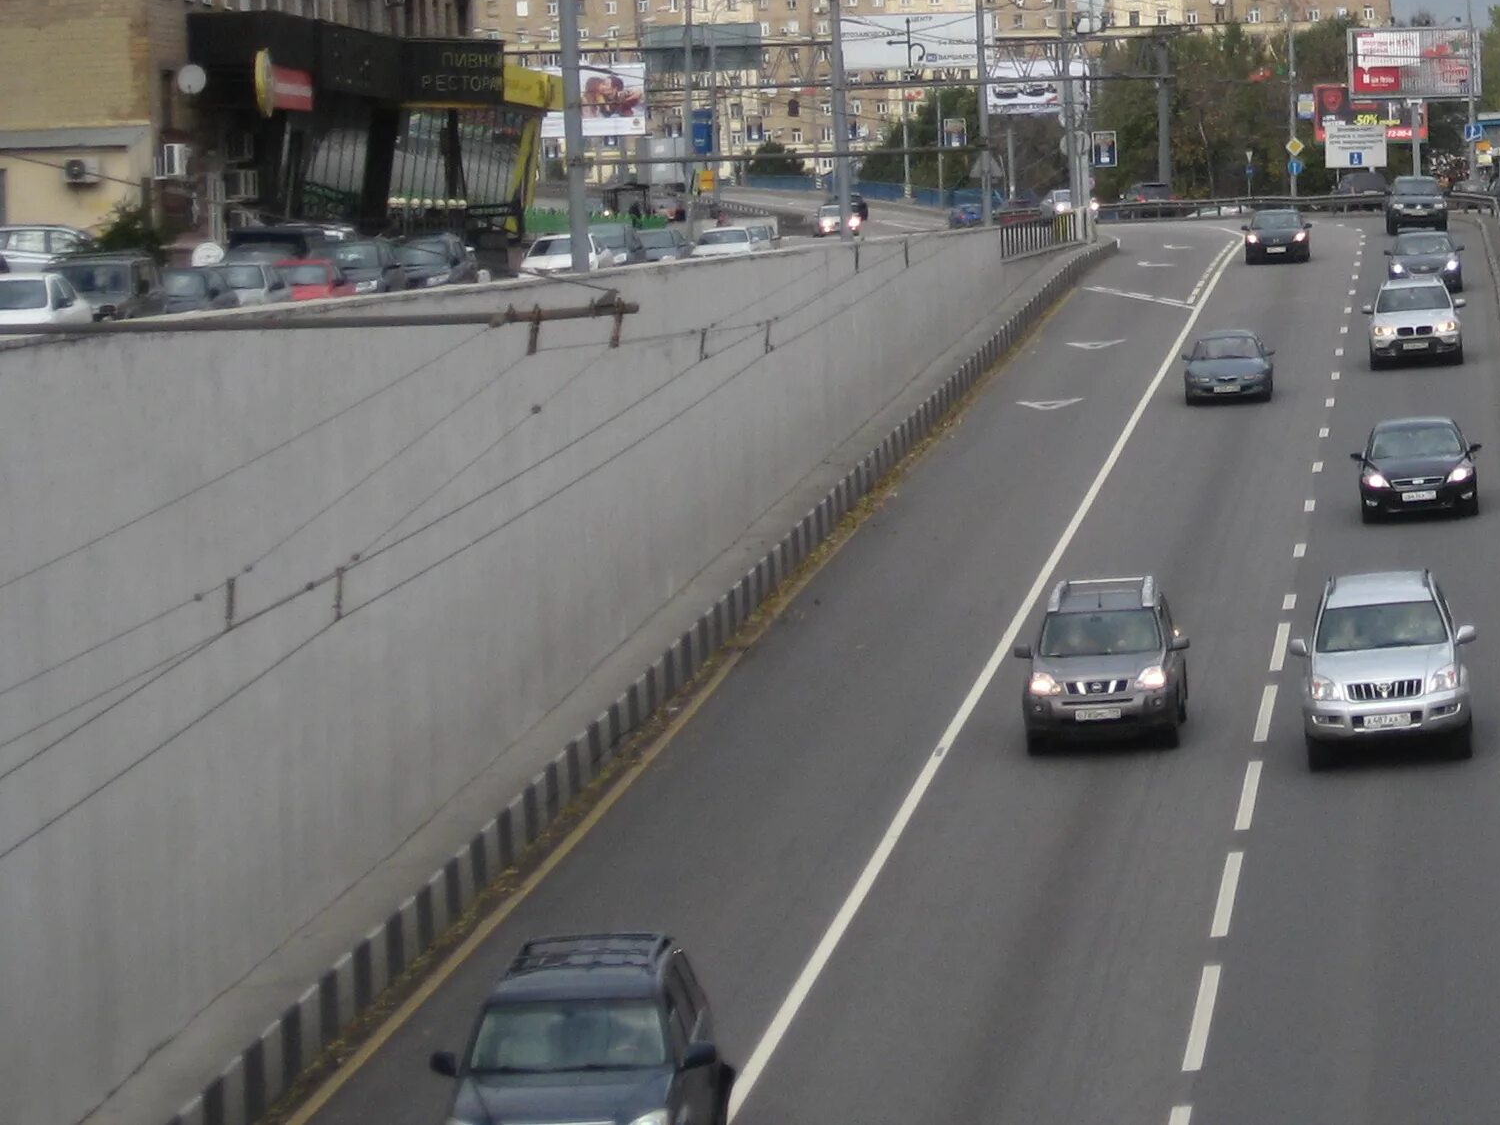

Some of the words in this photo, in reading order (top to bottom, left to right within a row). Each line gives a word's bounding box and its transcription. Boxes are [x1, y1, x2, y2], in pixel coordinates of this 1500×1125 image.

[911, 16, 933, 24] ЦЕНТР
[841, 29, 896, 38] ВТОЗАВОДСКАЯ
[1353, 114, 1379, 126] -50%
